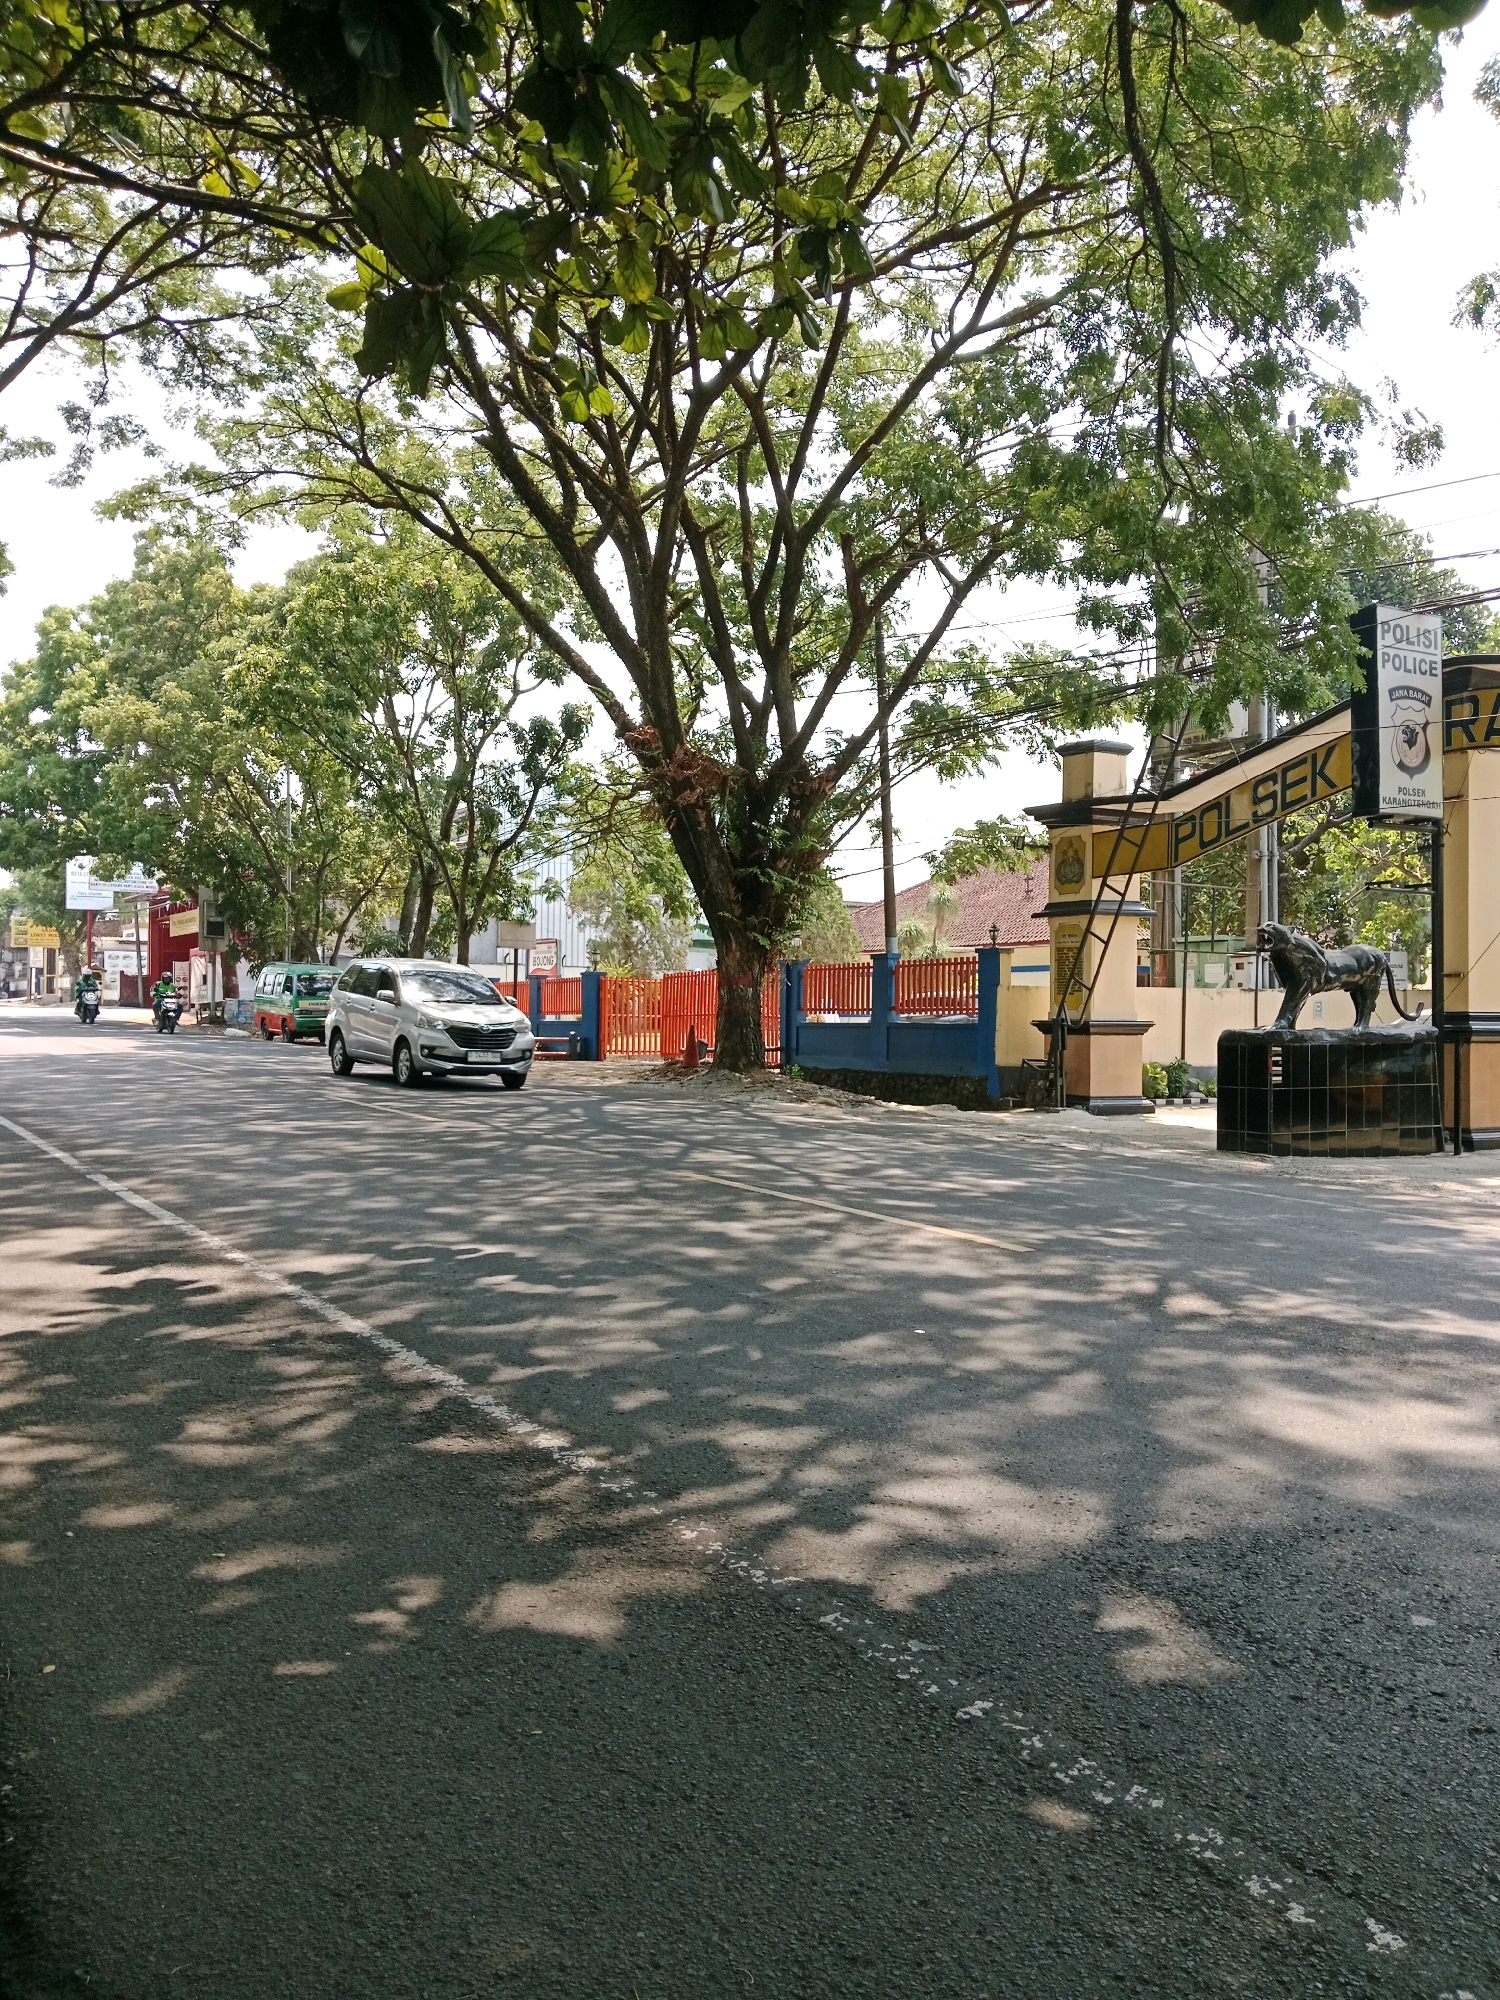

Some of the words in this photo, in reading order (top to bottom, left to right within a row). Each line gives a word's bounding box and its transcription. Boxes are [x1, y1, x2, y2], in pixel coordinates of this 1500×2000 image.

[1380, 620, 1438, 650] POLISI
[1381, 651, 1439, 678] POLICE
[1391, 689, 1408, 699] JAWA
[1409, 690, 1430, 704] BARAT
[1397, 786, 1426, 798] POLSEK
[1174, 743, 1338, 863] POLSEK
[532, 955, 554, 967] BOJONG
